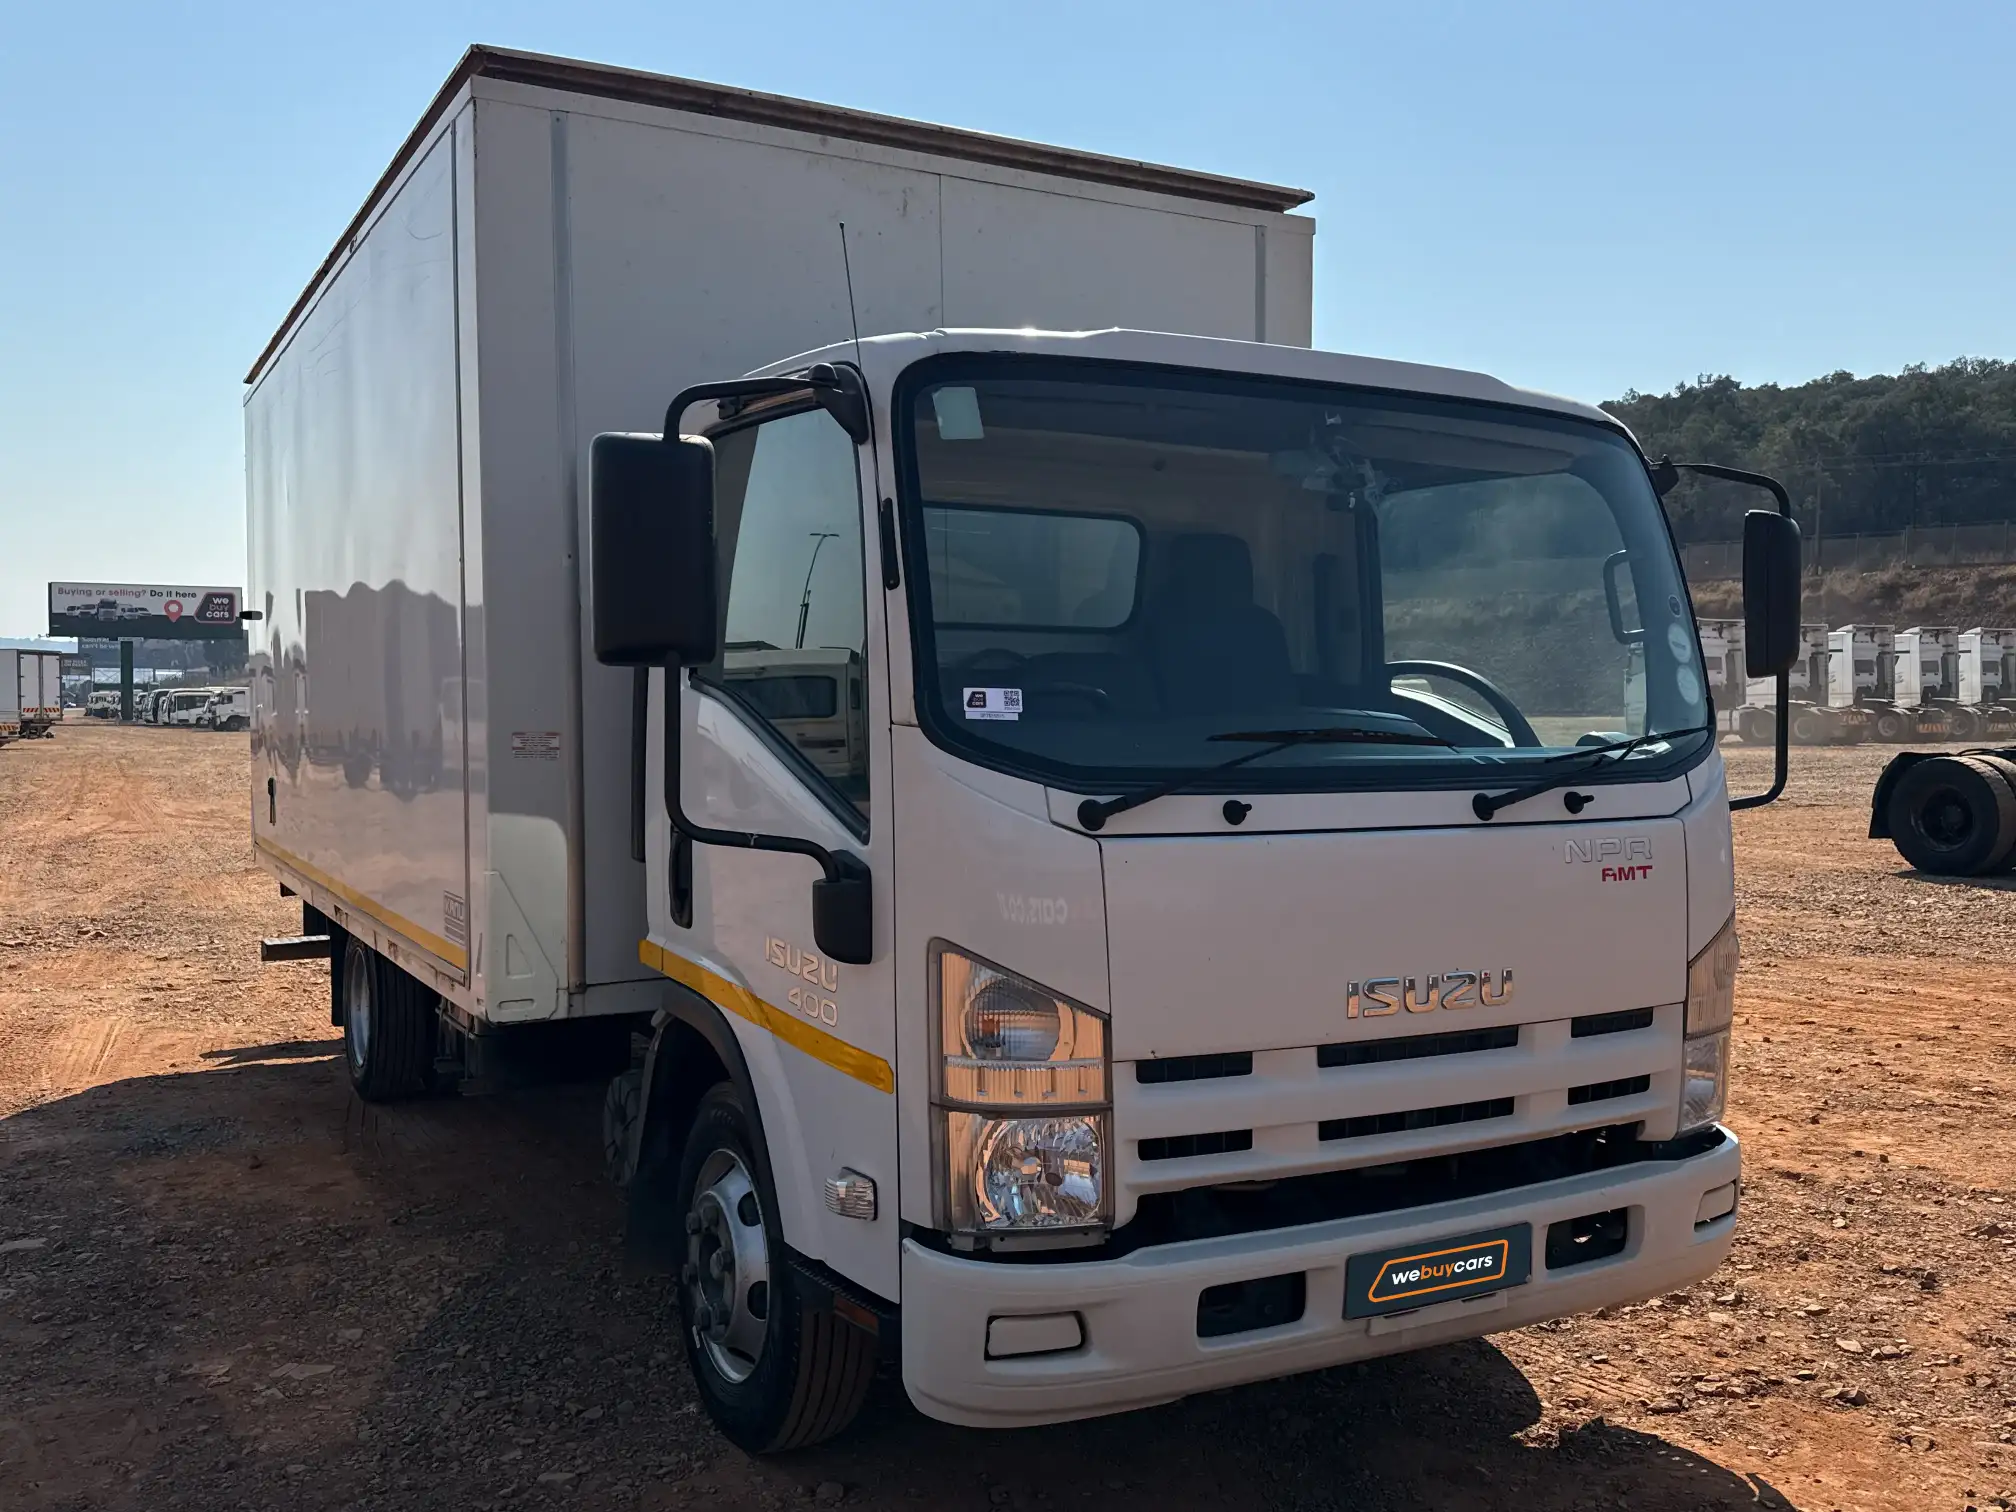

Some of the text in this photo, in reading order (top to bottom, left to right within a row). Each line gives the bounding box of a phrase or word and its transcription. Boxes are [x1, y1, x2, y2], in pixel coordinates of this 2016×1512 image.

[57, 587, 92, 597] Buying
[108, 589, 146, 598] selling?
[150, 589, 163, 598] Do
[209, 603, 229, 611] buy
[1564, 837, 1653, 863] NPR
[1601, 865, 1653, 882] AMT
[764, 935, 839, 993] ISUZU
[1347, 967, 1514, 1018] ISUZU
[787, 987, 838, 1028] 400
[1391, 1255, 1493, 1285] webuycars
